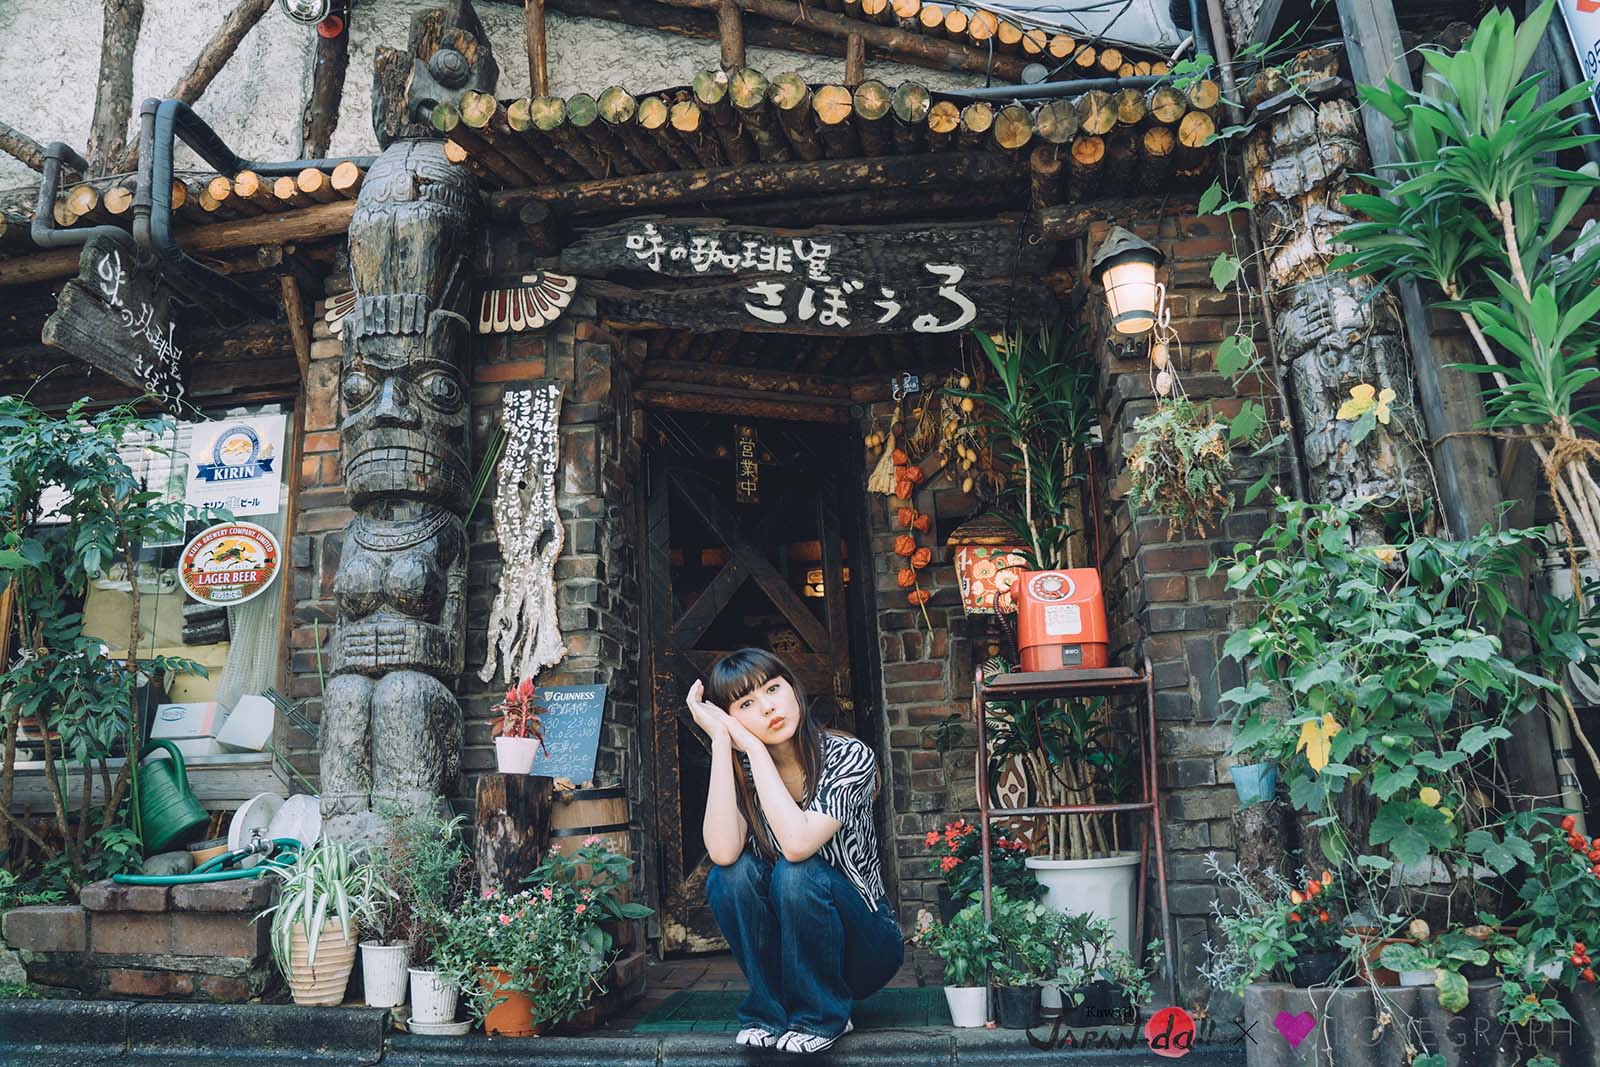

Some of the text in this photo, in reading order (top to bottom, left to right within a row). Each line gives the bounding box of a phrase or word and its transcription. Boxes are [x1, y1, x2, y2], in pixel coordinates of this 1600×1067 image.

[626, 223, 832, 282] 味の珈琲屋
[745, 262, 977, 333] さぼうる
[214, 466, 254, 480] KIRIN
[740, 437, 757, 497] 営業中
[240, 497, 260, 508] ビール
[202, 527, 228, 544] BREWERY
[229, 526, 256, 537] COMPANY
[255, 531, 274, 553] LIMITED
[198, 571, 257, 585] LAGER BEER
[553, 691, 596, 701] GUINNESS
